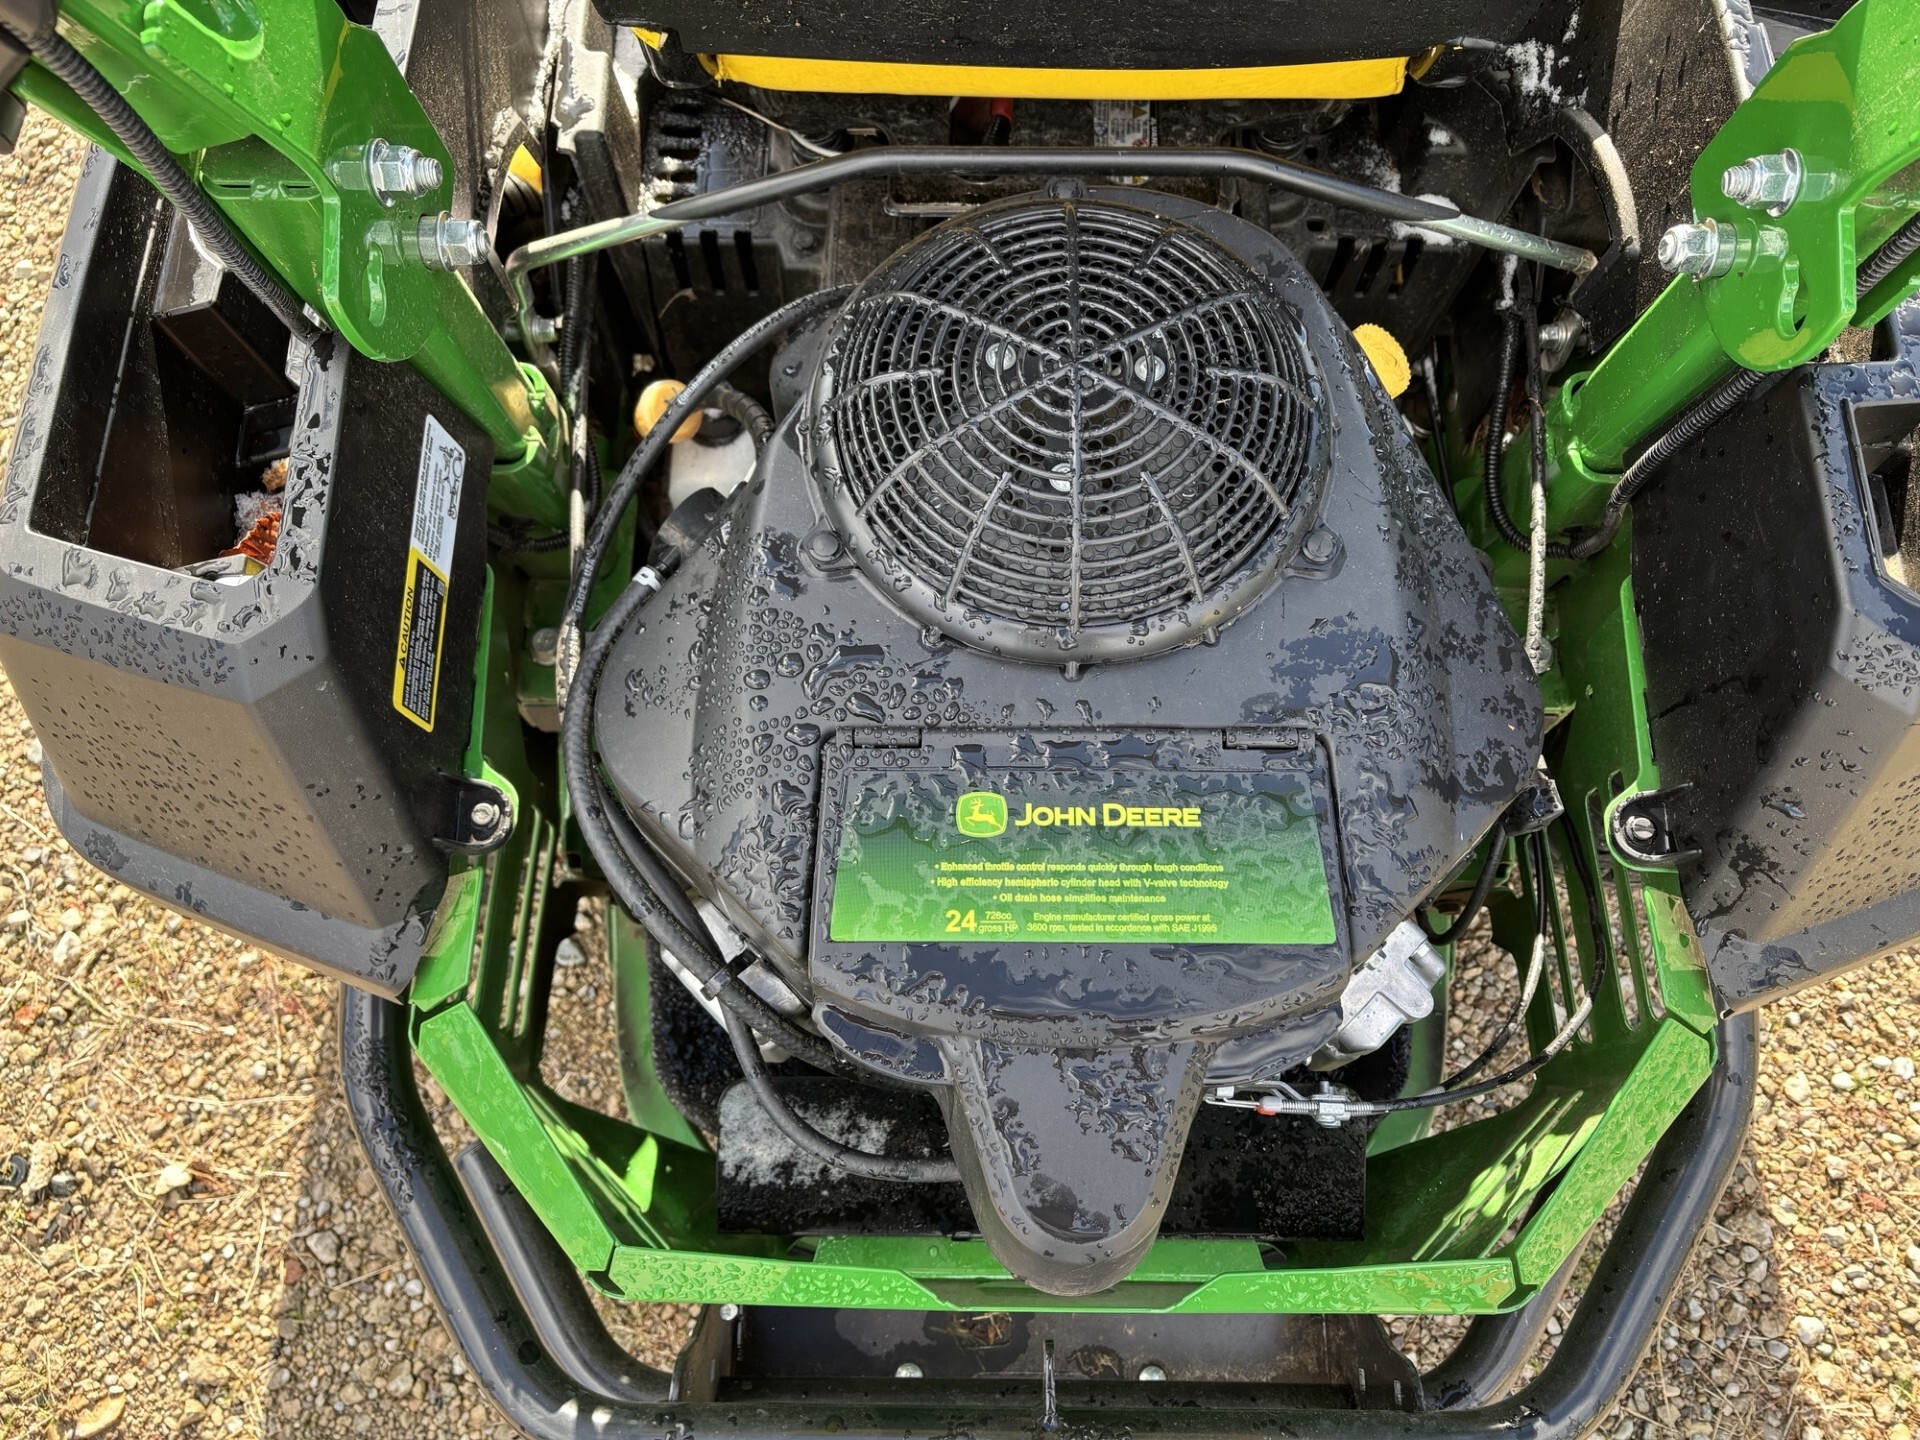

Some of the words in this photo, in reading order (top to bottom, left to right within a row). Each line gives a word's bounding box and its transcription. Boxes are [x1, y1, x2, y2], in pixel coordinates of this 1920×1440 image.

[583, 558, 595, 576] USA
[580, 577, 589, 587] IN
[575, 587, 586, 612] MADE
[401, 587, 413, 653] CAUTION
[1014, 803, 1097, 827] JOHN
[1102, 803, 1201, 827] DEERE
[940, 862, 983, 872] Enhanced
[985, 862, 1015, 872] throttle
[1017, 862, 1045, 872] control
[1047, 862, 1086, 873] responds
[1088, 862, 1117, 873] quickly
[1119, 862, 1152, 873] through
[1154, 862, 1178, 873] tough
[1180, 862, 1224, 872] conditions
[937, 877, 958, 889] High
[960, 877, 1002, 889] efficiency
[1005, 877, 1059, 889] hemispheric
[1061, 877, 1096, 889] cylinder
[1098, 877, 1120, 887] head
[1123, 877, 1141, 887] with
[1143, 877, 1177, 887] V-valve
[1180, 877, 1229, 889] technology
[1000, 893, 1013, 902] Oil
[1015, 893, 1038, 902] drain
[1040, 893, 1062, 902] hose
[1064, 893, 1107, 904] simplifies
[1109, 893, 1166, 902] maintenance
[945, 909, 977, 933] 24
[1033, 913, 1062, 923] Engine
[1063, 913, 1116, 921] manufacturer
[1117, 913, 1149, 921] certified
[1151, 913, 1174, 923] gross
[1175, 913, 1200, 923] power
[1202, 913, 1211, 921] at
[979, 925, 1003, 934] gross
[1004, 923, 1019, 932] HP
[1027, 923, 1047, 932] 3600
[1069, 923, 1094, 932] tested
[1096, 923, 1104, 932] in
[1105, 923, 1152, 932] accordance
[1154, 923, 1170, 932] with
[1172, 923, 1190, 932] SAE
[1192, 923, 1217, 932] J1995
